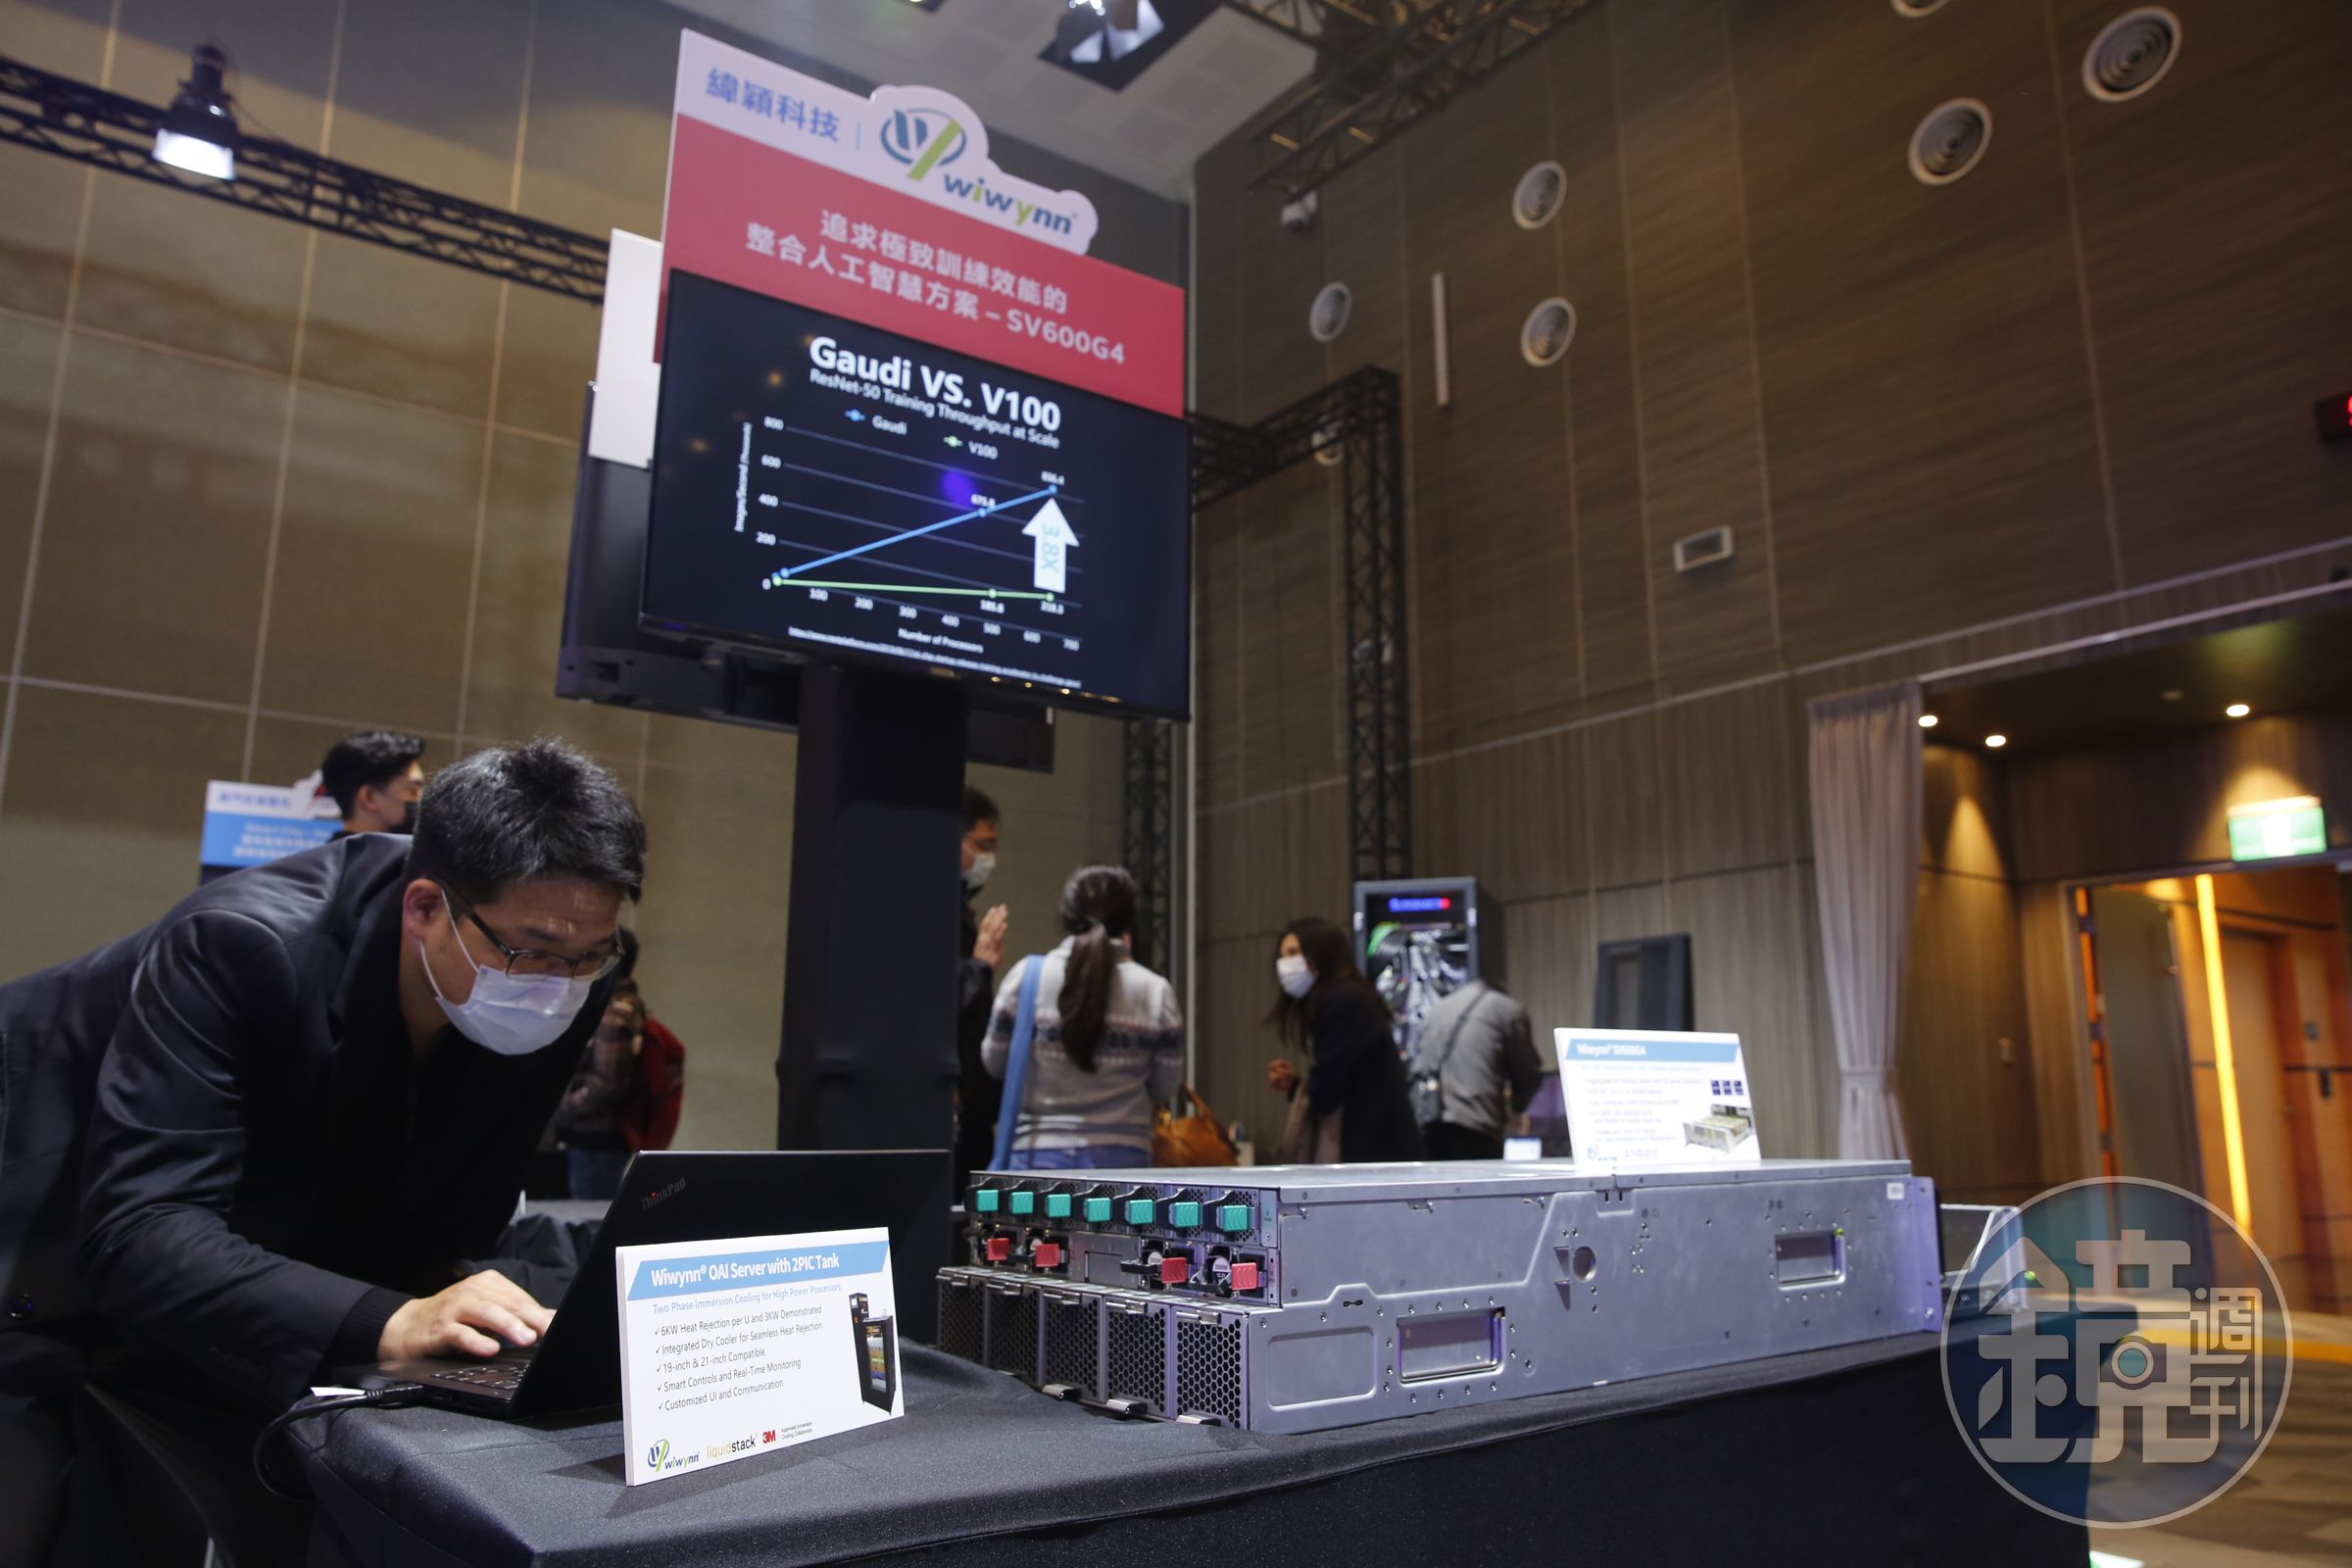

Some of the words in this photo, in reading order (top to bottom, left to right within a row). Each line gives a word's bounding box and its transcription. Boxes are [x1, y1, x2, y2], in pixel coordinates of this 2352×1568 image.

[705, 68, 840, 142] 緯穎科技
[943, 173, 1073, 235] wiwynn
[820, 209, 1068, 315] 追求極致訓練效能的
[809, 336, 912, 391] Gaudi
[920, 366, 972, 408] VS.
[981, 383, 1061, 431] V100
[809, 368, 881, 400] ResNet-50
[883, 389, 935, 418] Training
[937, 403, 1011, 435] Throughput
[1012, 424, 1026, 440] at
[1028, 429, 1060, 449] Scale
[872, 416, 907, 435] Gaudi
[968, 441, 998, 460] V100
[641, 1176, 686, 1210] ThinkPad
[709, 1264, 729, 1281] OAI
[730, 1261, 767, 1278] Server
[768, 1257, 791, 1274] with
[792, 1254, 814, 1272] 2PIC
[815, 1252, 839, 1268] Tank
[653, 1303, 669, 1314] Two
[670, 1299, 693, 1311] Phase
[695, 1295, 733, 1309] Immersion
[735, 1291, 760, 1305] Cooling
[761, 1289, 772, 1301] for
[772, 1286, 789, 1301] High
[790, 1285, 808, 1298] Power
[810, 1283, 842, 1295] Processors
[661, 1326, 678, 1337] 6KW
[680, 1322, 697, 1333] Heat
[699, 1316, 730, 1333] Rejection
[731, 1318, 743, 1328] per
[744, 1314, 750, 1324] U
[751, 1312, 763, 1324] and
[764, 1310, 779, 1322] 3KW
[780, 1304, 822, 1319] Demonstrated
[662, 1340, 700, 1355] Integrated
[701, 1338, 713, 1350] Dry
[715, 1334, 738, 1347] Cooler
[739, 1332, 749, 1343] for
[750, 1327, 779, 1342] Seamless
[779, 1325, 795, 1336] Heat
[795, 1321, 822, 1334] Rejection
[663, 1360, 691, 1373] 19-inch
[692, 1357, 700, 1367] &
[701, 1352, 726, 1367] 21-inch
[728, 1347, 765, 1362] Compatible
[663, 1379, 686, 1393] Smart
[687, 1373, 717, 1388] Controls
[718, 1370, 732, 1382] and
[733, 1363, 765, 1379] Real-Time
[766, 1358, 802, 1374] Monitoring
[664, 1393, 708, 1411] Customized
[718, 1387, 732, 1399] and
[733, 1380, 784, 1397] Communication
[707, 1435, 757, 1459] liquidstack
[762, 1429, 776, 1445] 3M
